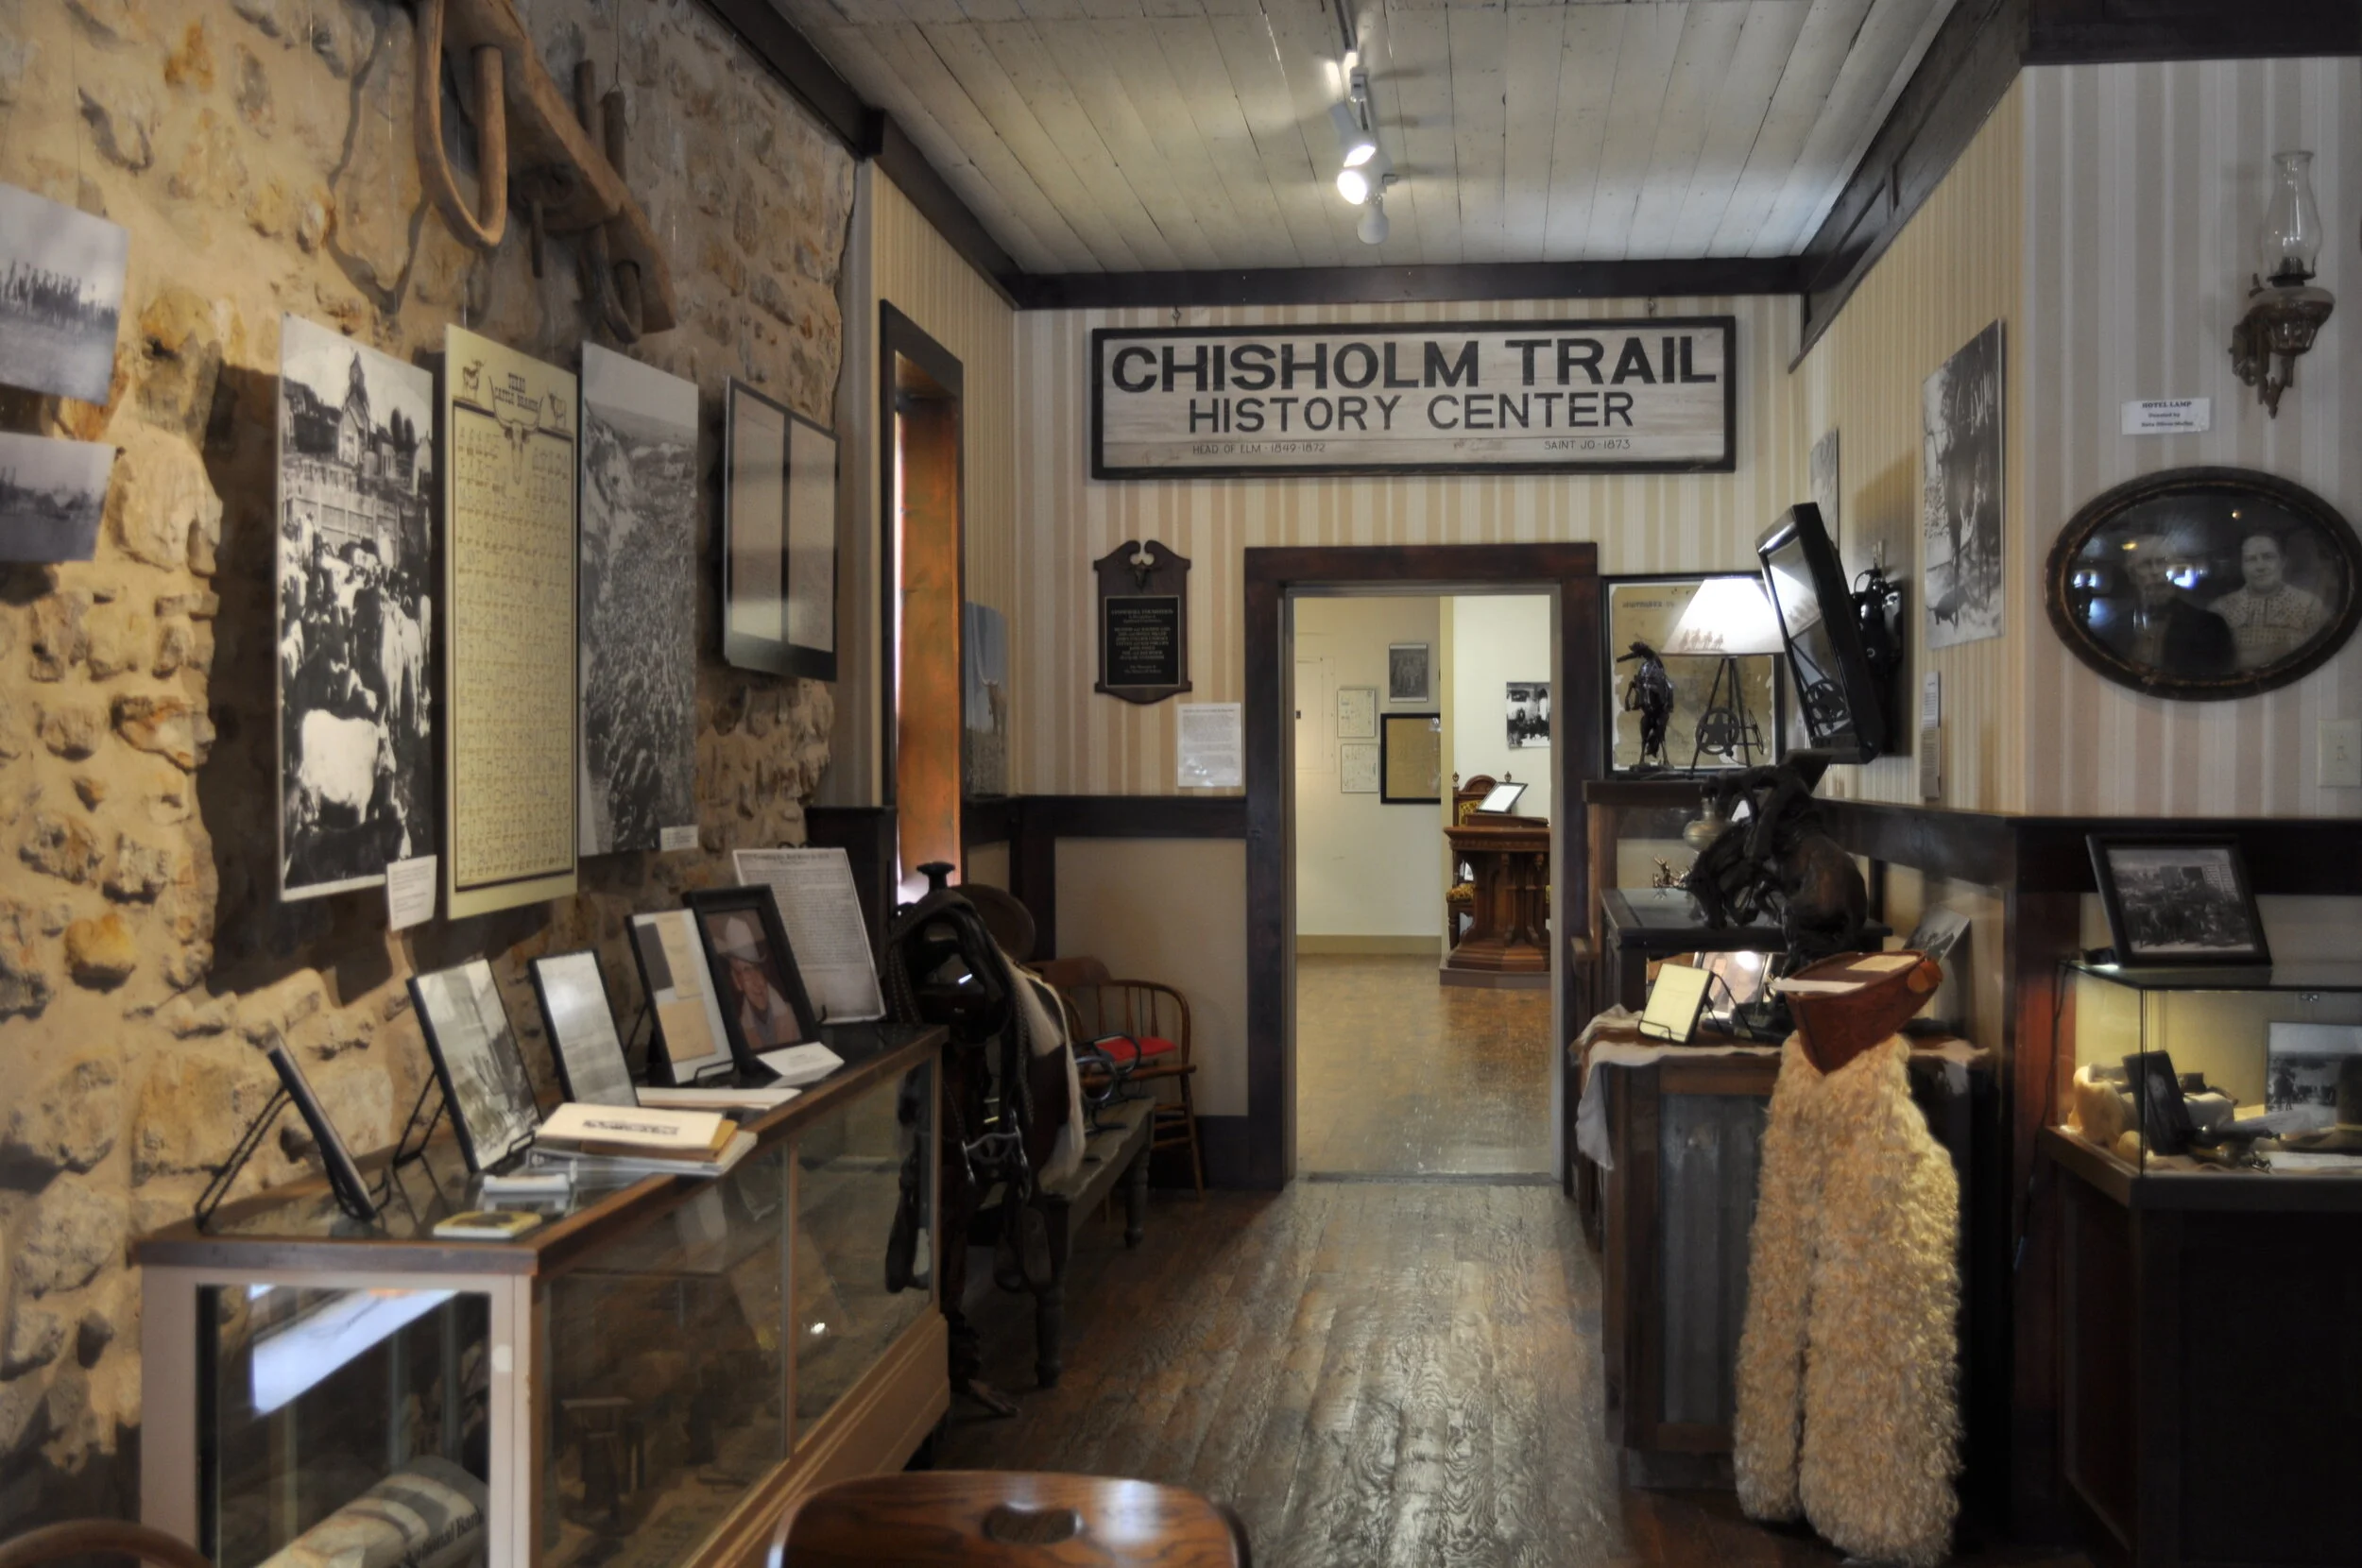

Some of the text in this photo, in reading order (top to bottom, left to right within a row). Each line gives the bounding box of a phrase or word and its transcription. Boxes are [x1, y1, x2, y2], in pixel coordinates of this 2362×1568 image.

[1111, 336, 1716, 393] CHISHOLM TRAIL
[2169, 400, 2192, 408] LAMP
[1188, 392, 1635, 434] HISTORY CENTER
[1192, 445, 1219, 454] HEAD
[1224, 444, 1235, 453] OF
[1240, 443, 1261, 453] ELM
[1544, 438, 1631, 450] SAINT JO 1873
